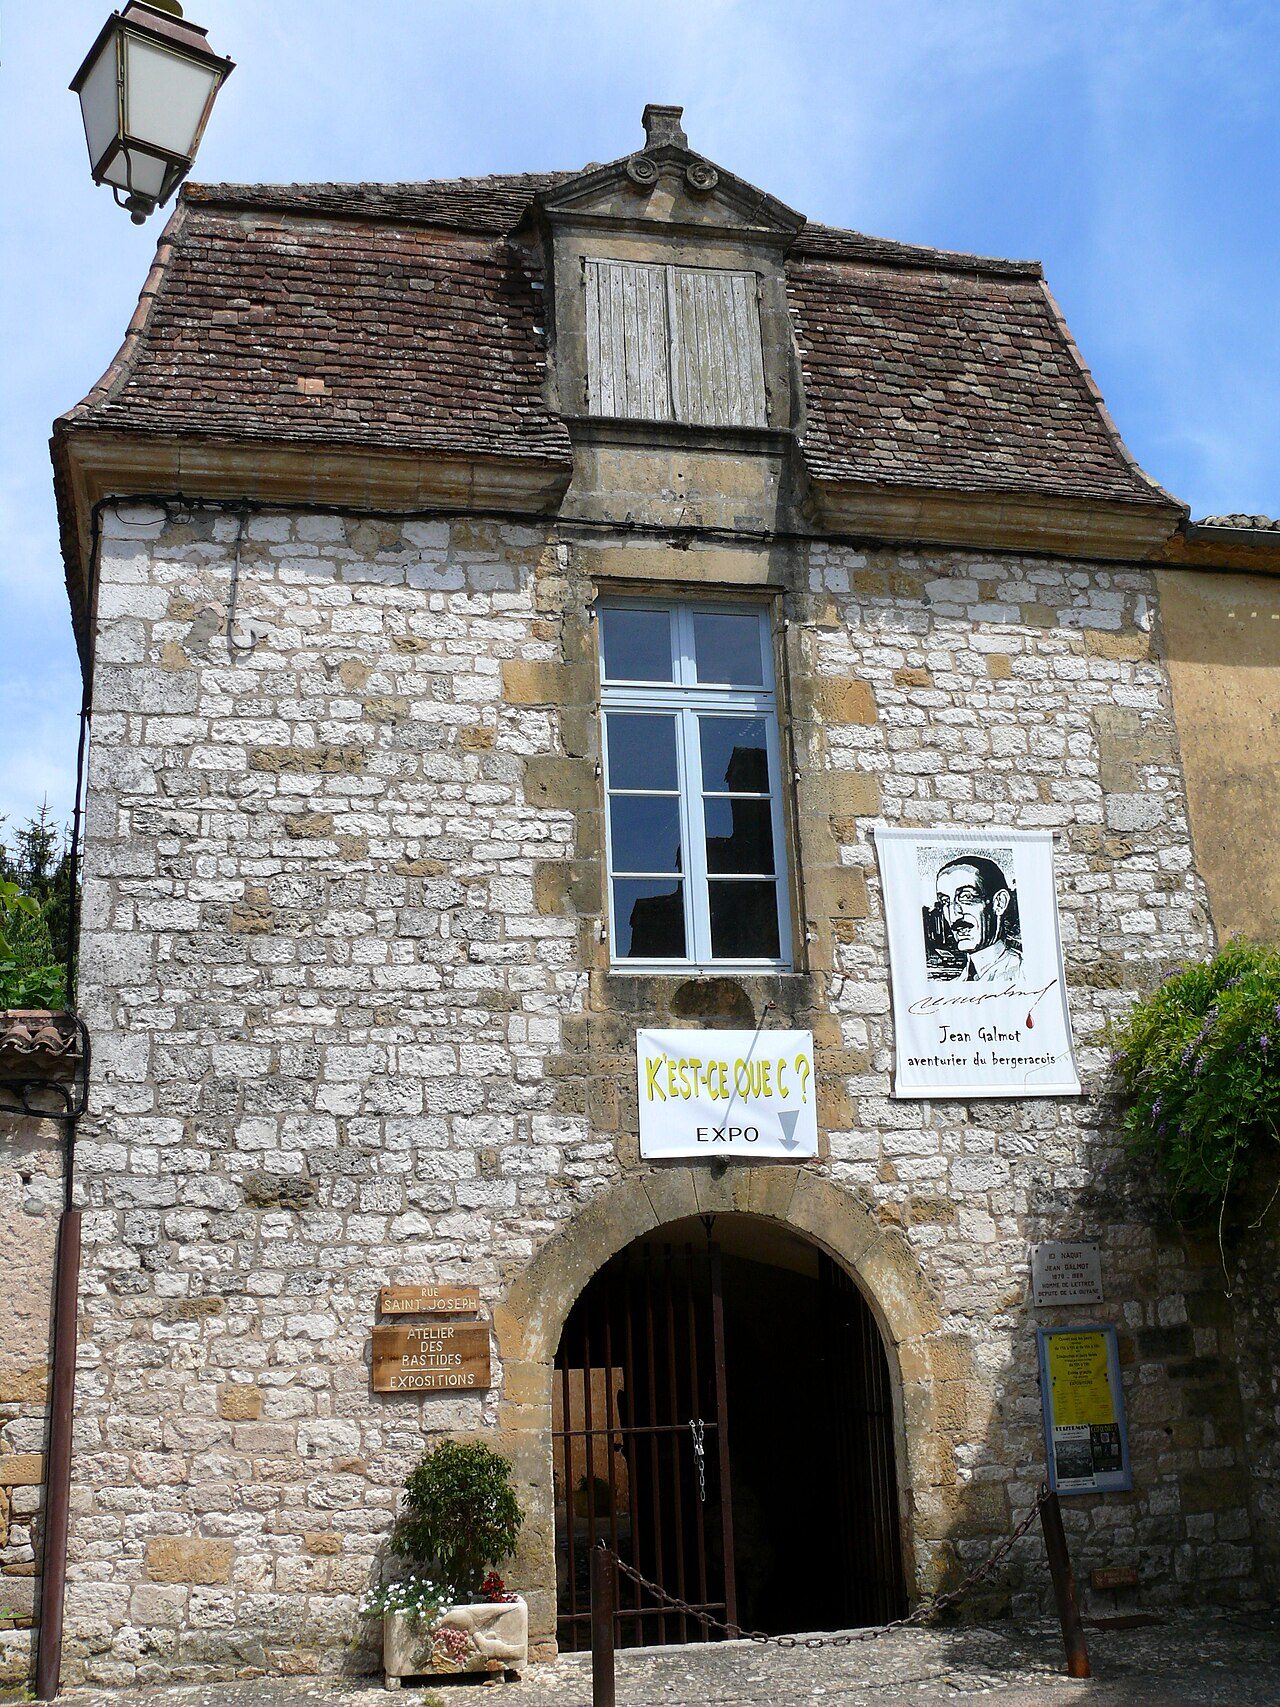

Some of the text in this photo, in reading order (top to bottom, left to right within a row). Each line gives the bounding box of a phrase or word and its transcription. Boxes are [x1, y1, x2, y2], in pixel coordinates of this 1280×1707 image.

[939, 1025, 1021, 1043] Jean Galmot
[908, 1051, 1056, 1069] aventurier du bergeracois
[734, 1058, 773, 1104] QUE
[777, 1058, 789, 1099] C
[696, 1127, 759, 1142] EXPO
[1064, 1263, 1089, 1271] GALMOT
[421, 1287, 439, 1297] RUE
[428, 1298, 477, 1310] JOSEPH
[407, 1327, 455, 1340] ATELIER
[420, 1341, 444, 1353] DES
[402, 1354, 462, 1366] BASTIDES
[390, 1373, 475, 1388] EXPOSITIONS
